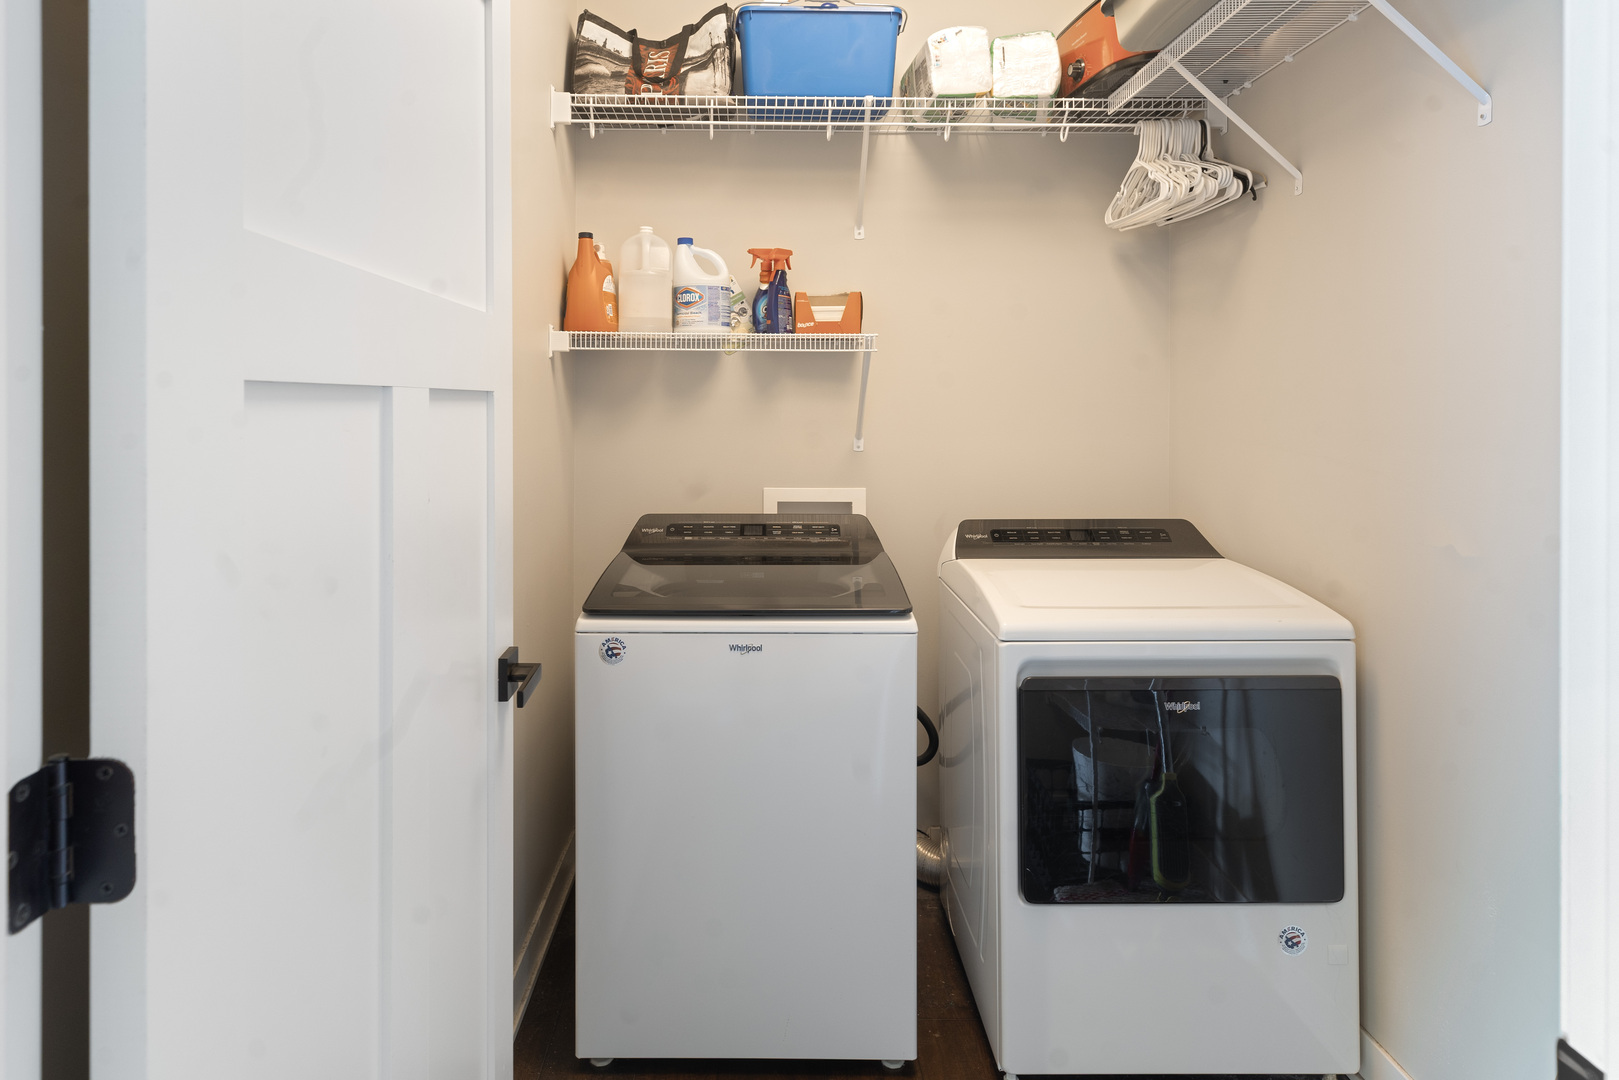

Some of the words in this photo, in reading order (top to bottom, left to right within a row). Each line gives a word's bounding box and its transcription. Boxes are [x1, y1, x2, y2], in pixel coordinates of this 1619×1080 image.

[640, 50, 671, 99] PRIS
[676, 293, 700, 303] CLOROX
[601, 637, 627, 650] AMERICA
[728, 643, 763, 654] Whirlpool
[1163, 701, 1201, 713] Whirlpool
[1279, 926, 1306, 940] AMERICA
